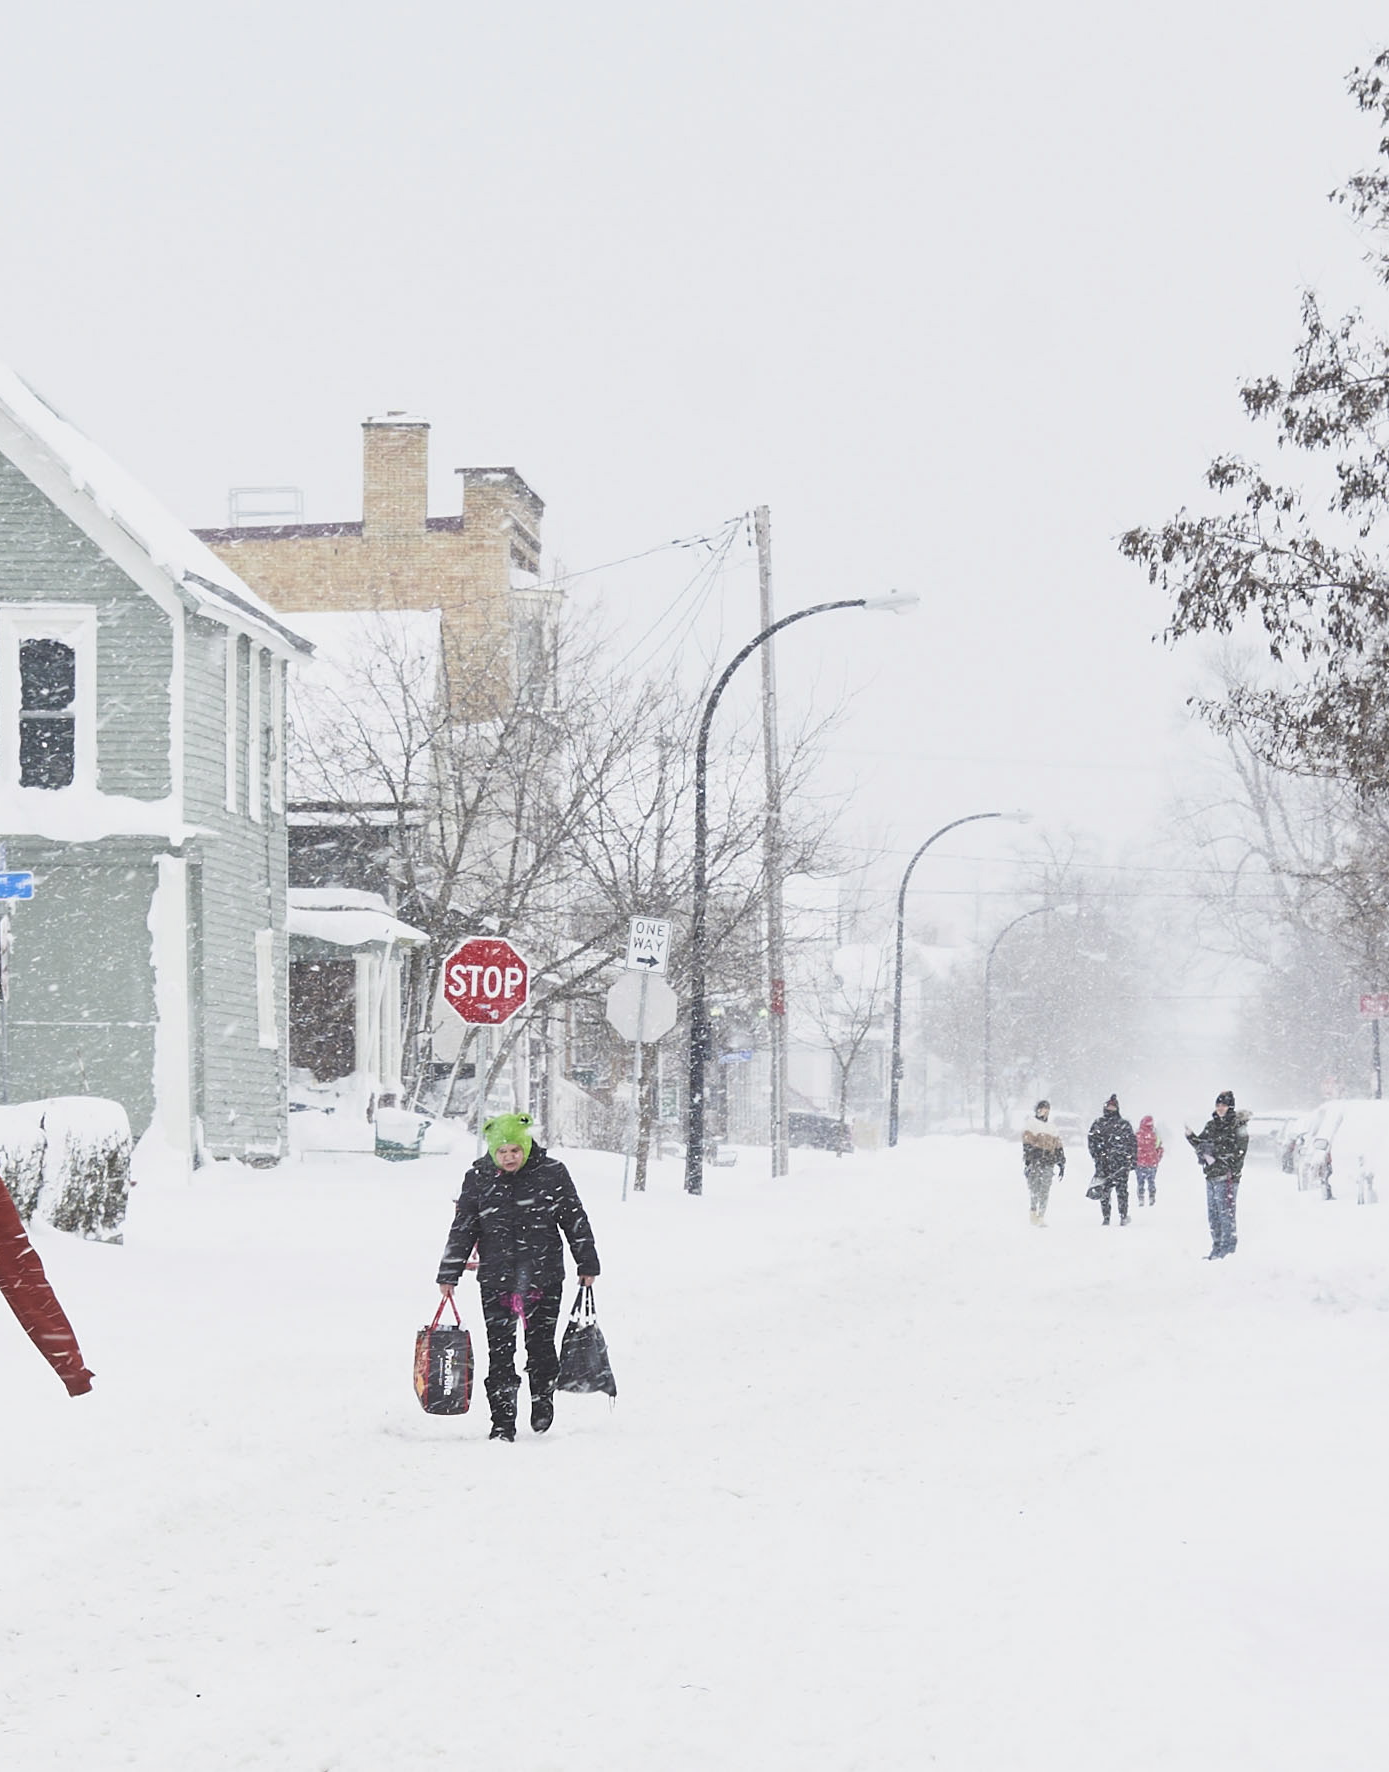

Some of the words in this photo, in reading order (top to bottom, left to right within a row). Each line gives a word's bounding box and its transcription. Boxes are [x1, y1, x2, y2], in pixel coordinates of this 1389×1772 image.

[636, 921, 666, 937] ONE
[633, 936, 664, 952] WAY
[448, 964, 523, 998] STOP
